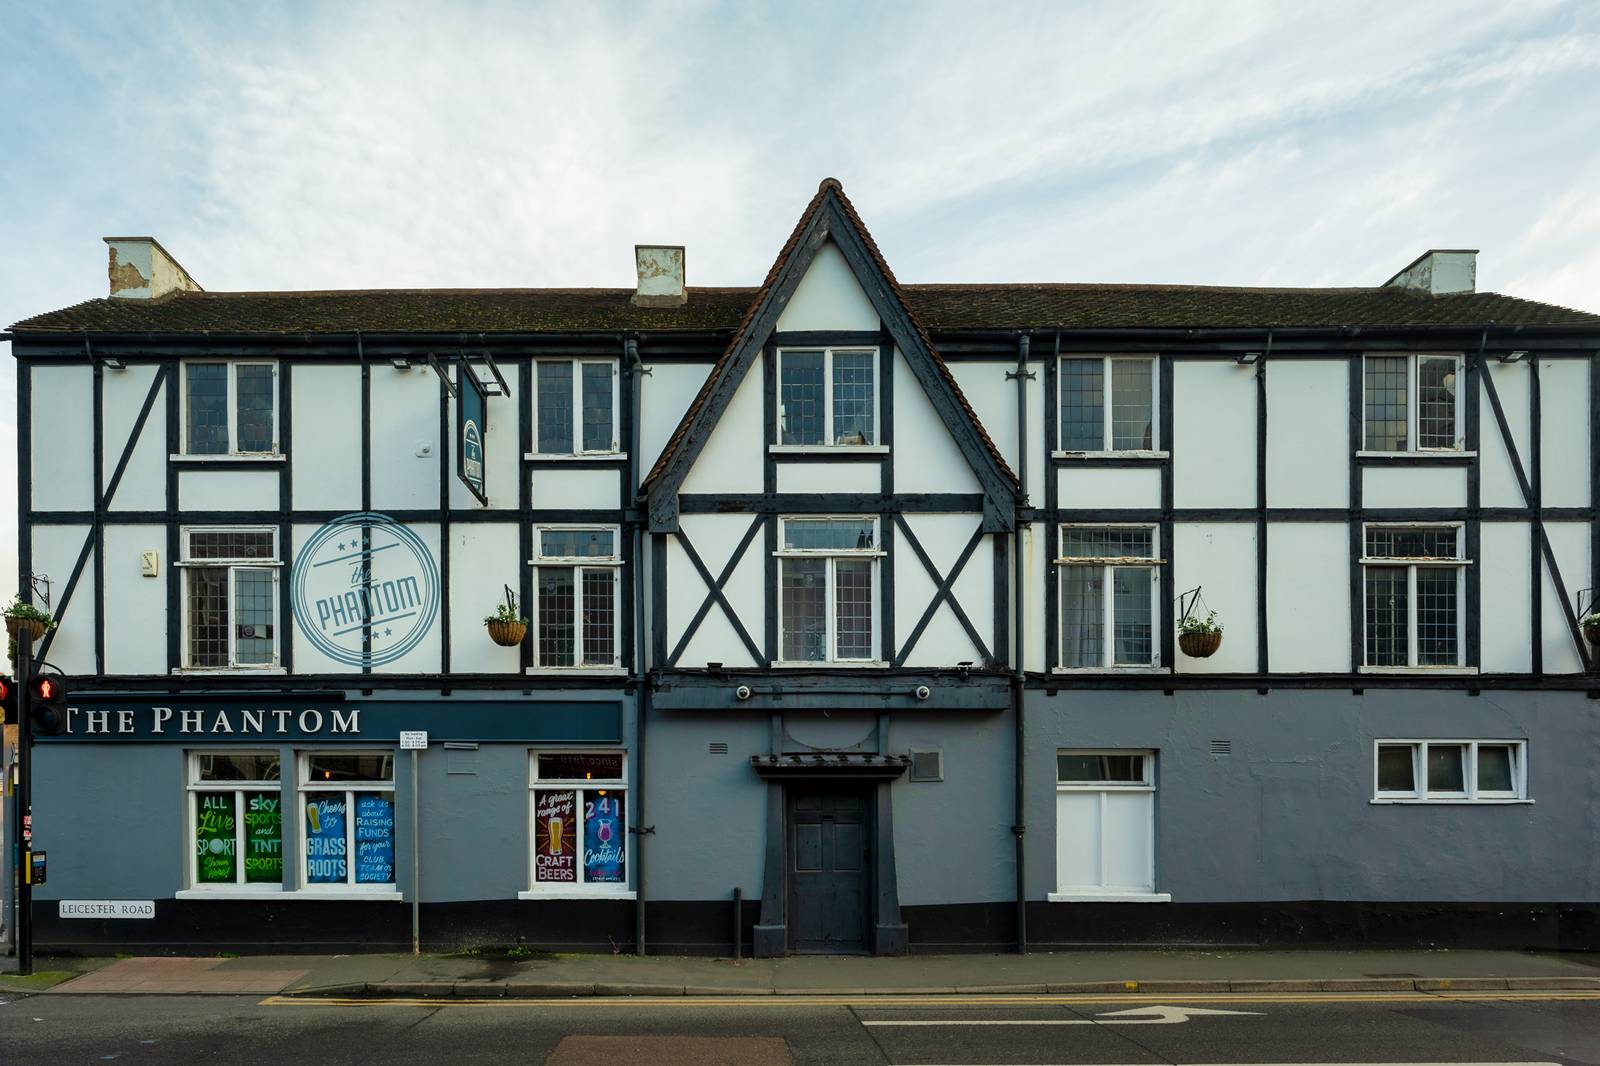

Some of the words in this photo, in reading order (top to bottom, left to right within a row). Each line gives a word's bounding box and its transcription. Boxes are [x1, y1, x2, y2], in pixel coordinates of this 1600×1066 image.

[316, 576, 421, 630] PHANTOM
[65, 707, 135, 733] THE
[151, 707, 360, 733] PHANTOM
[204, 796, 227, 809] ALL
[250, 794, 278, 812] sky
[361, 800, 376, 808] ask
[538, 794, 547, 807] A
[548, 791, 574, 806] great
[319, 800, 346, 815] Cheers
[537, 805, 560, 818] range
[561, 802, 573, 815] of
[197, 810, 234, 835] Live
[245, 812, 282, 826] sports
[324, 816, 338, 828] to
[356, 818, 393, 826] RAISING
[256, 826, 274, 835] and
[358, 828, 389, 837] FUNDS
[251, 839, 282, 852] TNT
[307, 838, 346, 855] GRASS
[360, 842, 371, 855] for
[372, 840, 391, 852] your
[536, 855, 573, 867] CRAFT
[584, 847, 624, 866] Cocktails
[246, 858, 283, 870] SPORTS
[308, 859, 346, 876] ROOTS
[538, 867, 573, 880] BEERS
[62, 903, 116, 915] LEICESTER
[122, 903, 153, 915] ROAD
